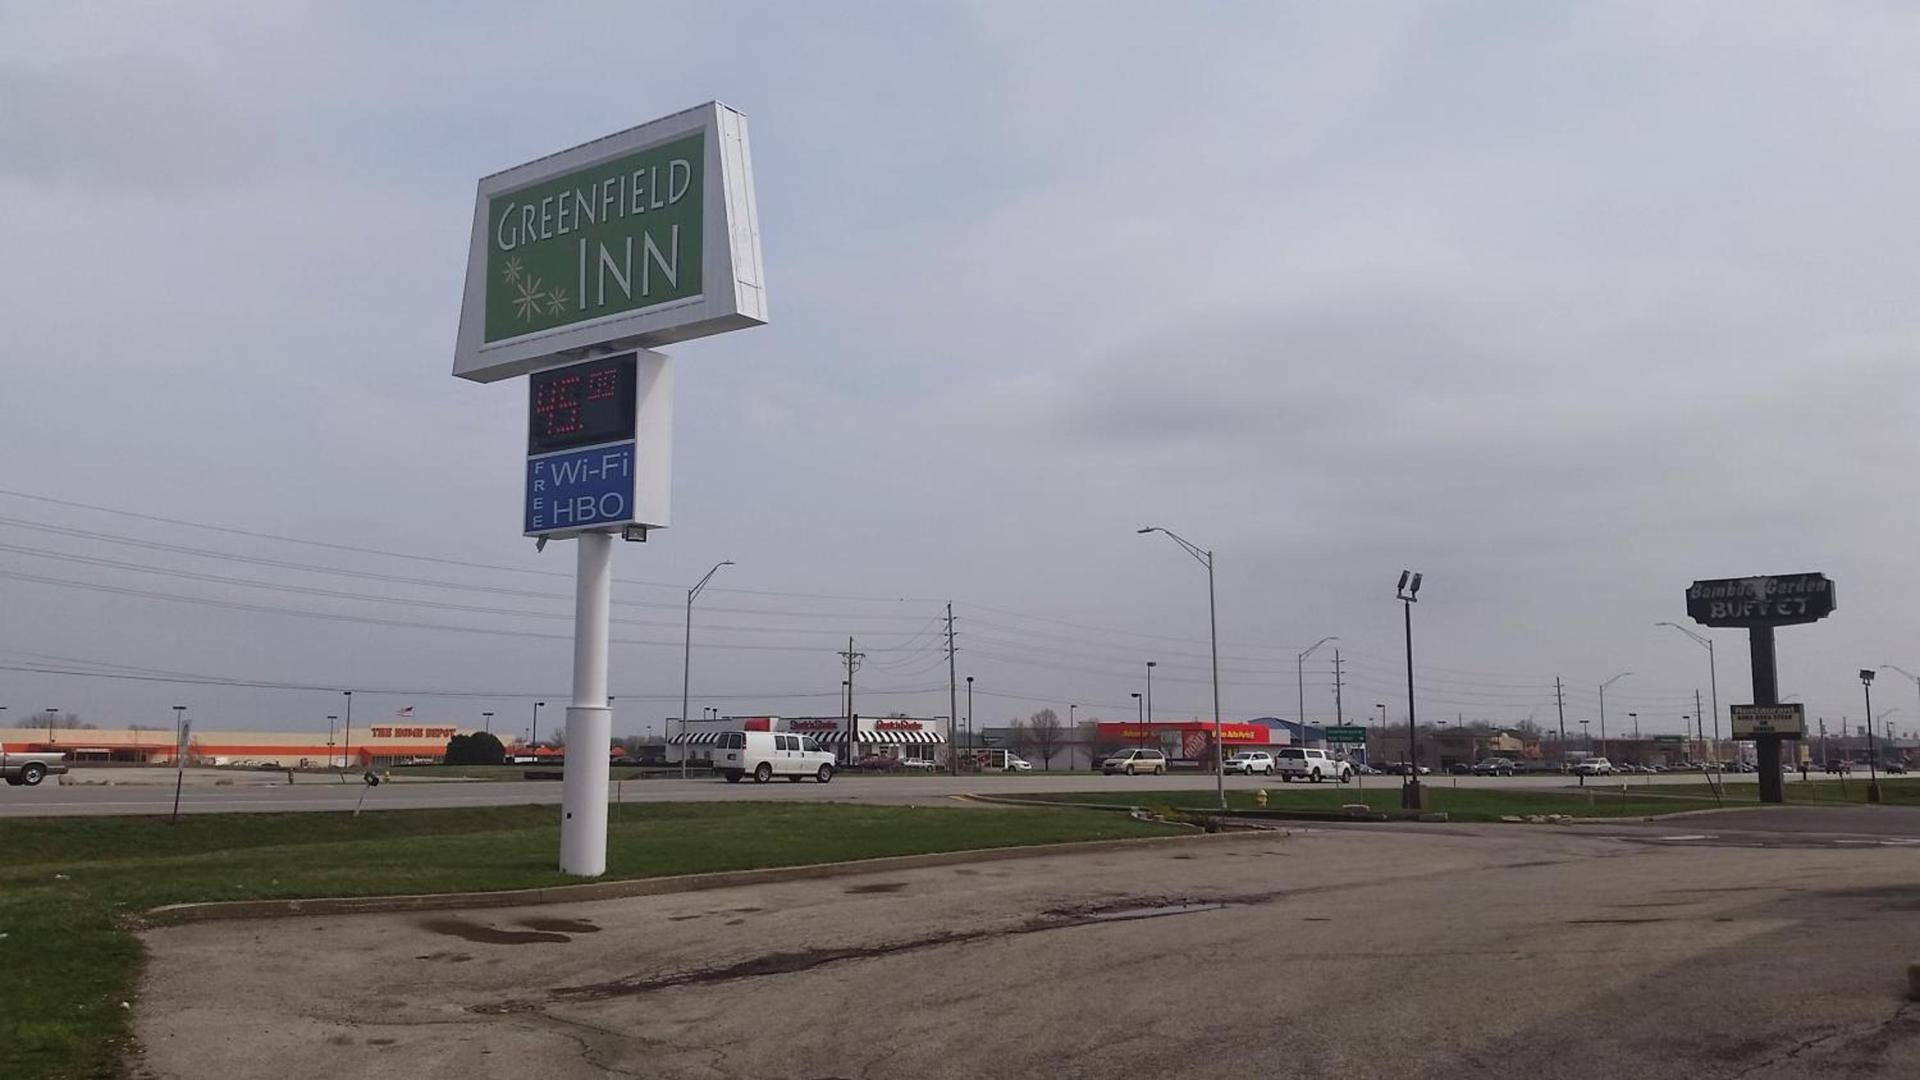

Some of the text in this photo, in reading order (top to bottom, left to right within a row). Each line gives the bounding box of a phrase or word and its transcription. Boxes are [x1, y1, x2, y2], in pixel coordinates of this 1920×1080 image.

[499, 158, 692, 251] GREENFIELD
[579, 224, 679, 310] INN
[551, 451, 629, 486] Wi-Fi
[533, 461, 545, 528] FREE
[553, 492, 625, 525] HBO
[1766, 576, 1827, 594] Garden
[1710, 596, 1809, 618] BUFFET
[371, 728, 457, 738] THE HOME DEPOT
